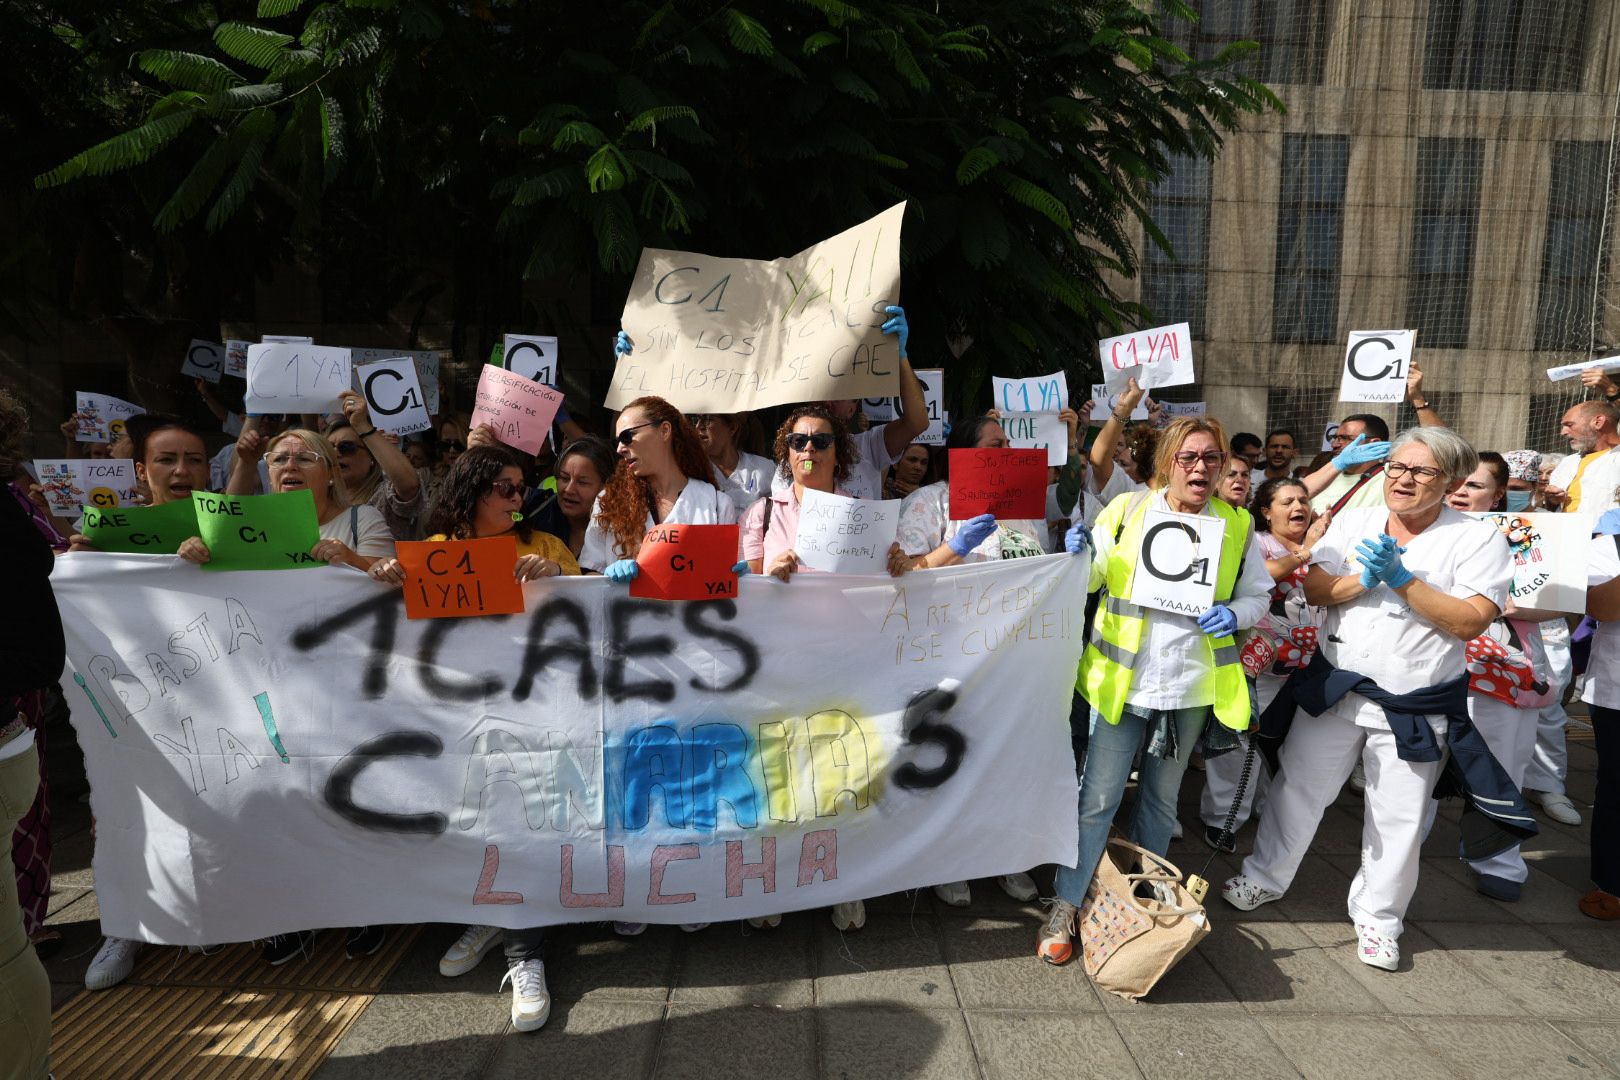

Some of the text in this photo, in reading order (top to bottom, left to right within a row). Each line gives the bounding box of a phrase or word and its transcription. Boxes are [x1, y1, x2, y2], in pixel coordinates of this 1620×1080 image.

[640, 323, 680, 353] SIN
[695, 330, 755, 356] LOS
[1112, 337, 1139, 370] C1
[620, 343, 890, 392] EL HOSPITAL SE CAE
[1347, 337, 1405, 381] C1
[250, 348, 305, 400] C1
[364, 368, 423, 416] C1
[1003, 379, 1062, 413] C1 YA
[525, 407, 537, 417] DE
[88, 465, 126, 478] TCAE
[92, 493, 116, 506] C1
[197, 498, 244, 516] TCAE
[845, 502, 866, 523] 76
[83, 511, 130, 529] TCAE
[837, 523, 869, 536] EBEP
[128, 532, 163, 546] C1
[238, 526, 268, 544] C1
[645, 529, 679, 544] TCAE
[426, 548, 476, 577] C1
[670, 553, 695, 573] C1
[1141, 520, 1213, 587] C1
[418, 576, 485, 611] ¡YA!
[704, 580, 733, 595] YA!
[959, 580, 998, 617] 76
[324, 687, 969, 834] CANARIAS
[472, 828, 839, 908] LUCHA
